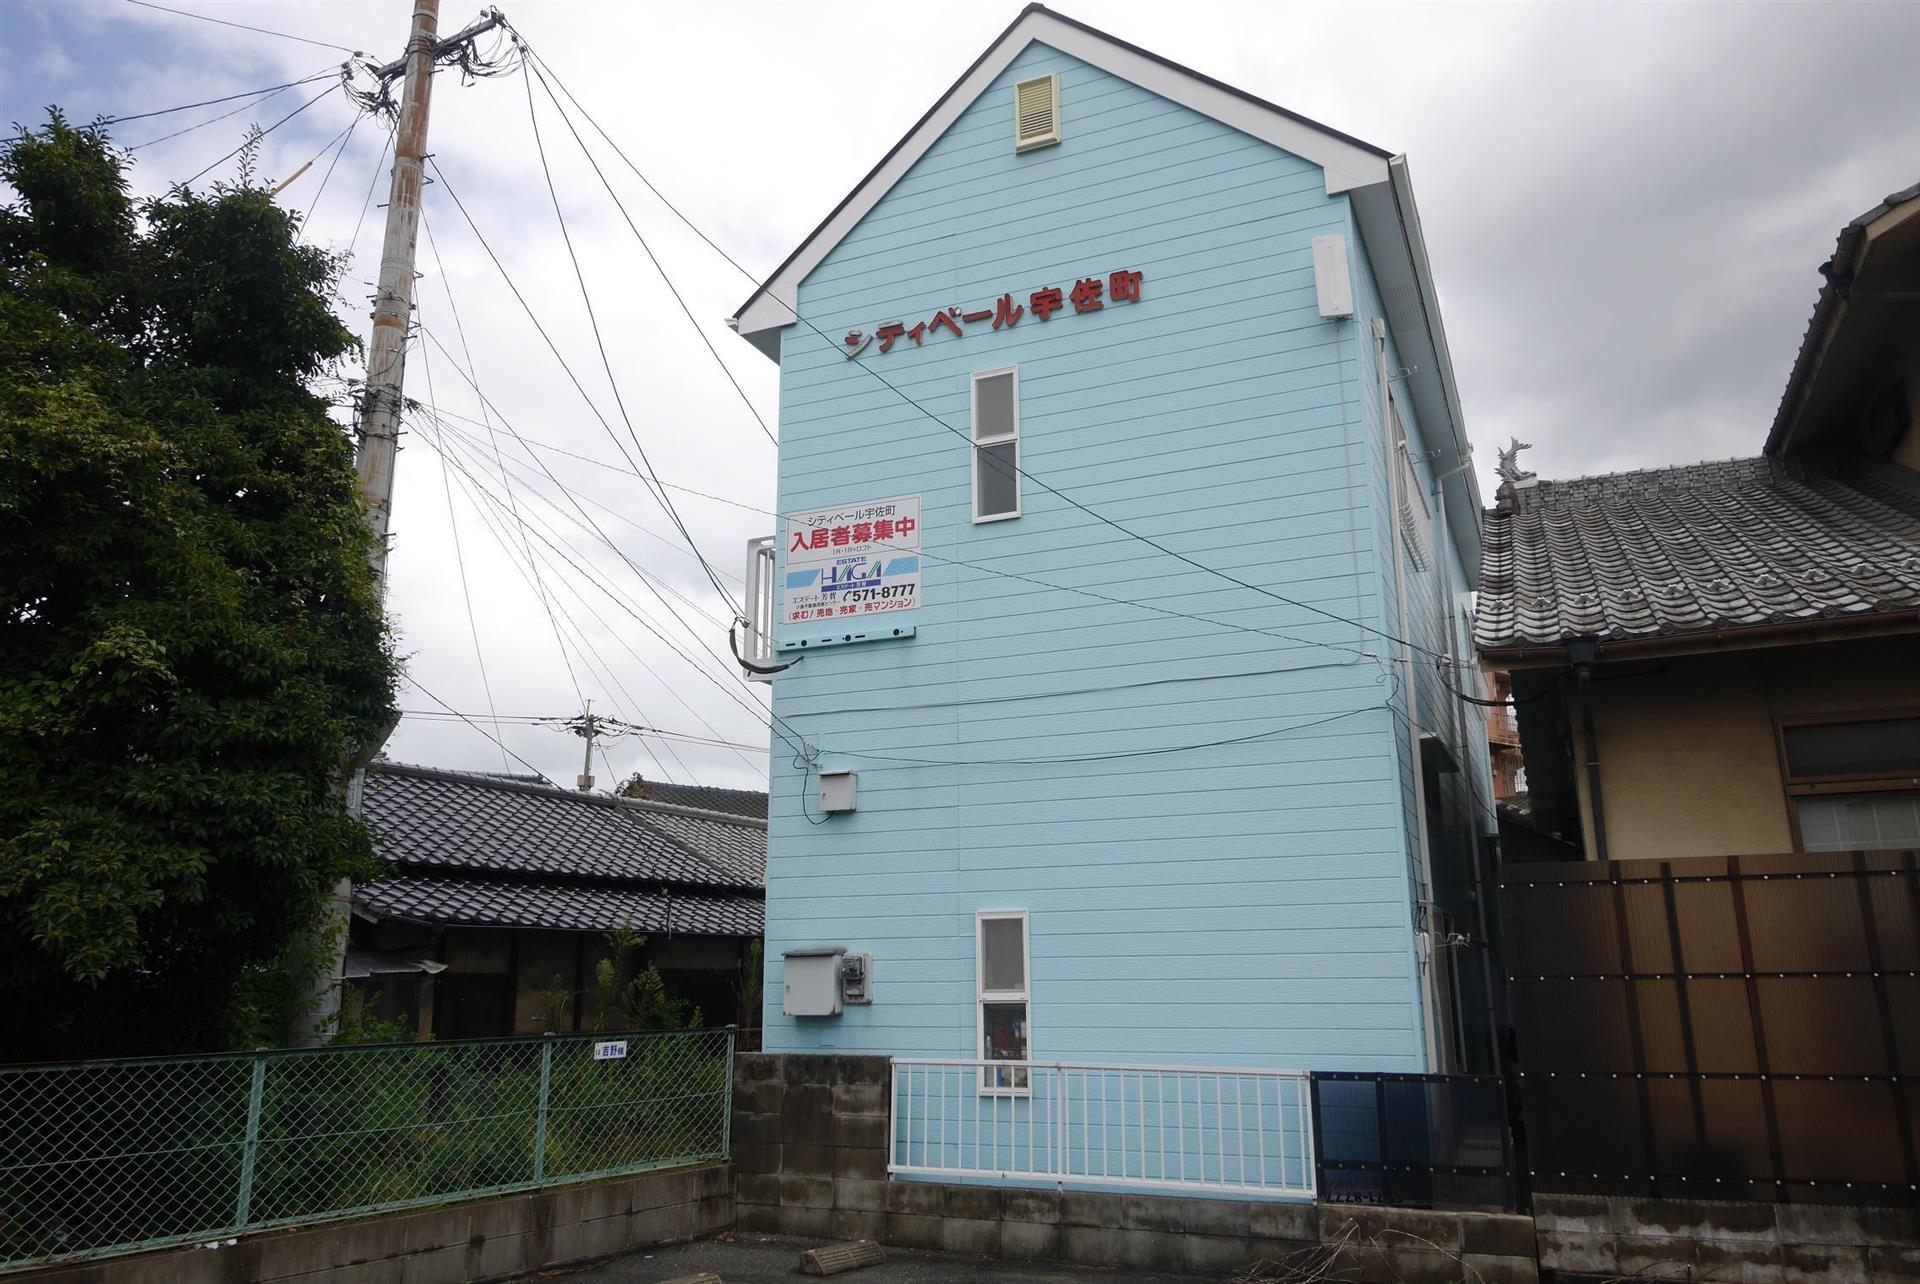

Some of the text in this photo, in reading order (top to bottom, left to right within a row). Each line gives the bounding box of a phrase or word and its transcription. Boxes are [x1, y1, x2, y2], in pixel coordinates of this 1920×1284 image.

[844, 270, 1144, 360] シティベール宇佐町
[808, 505, 896, 527] シティベール宇佐町
[790, 516, 915, 553] 入居者募集中
[821, 560, 882, 586] HAGA
[836, 556, 867, 566] ESTATE
[852, 583, 915, 602] 571-8777
